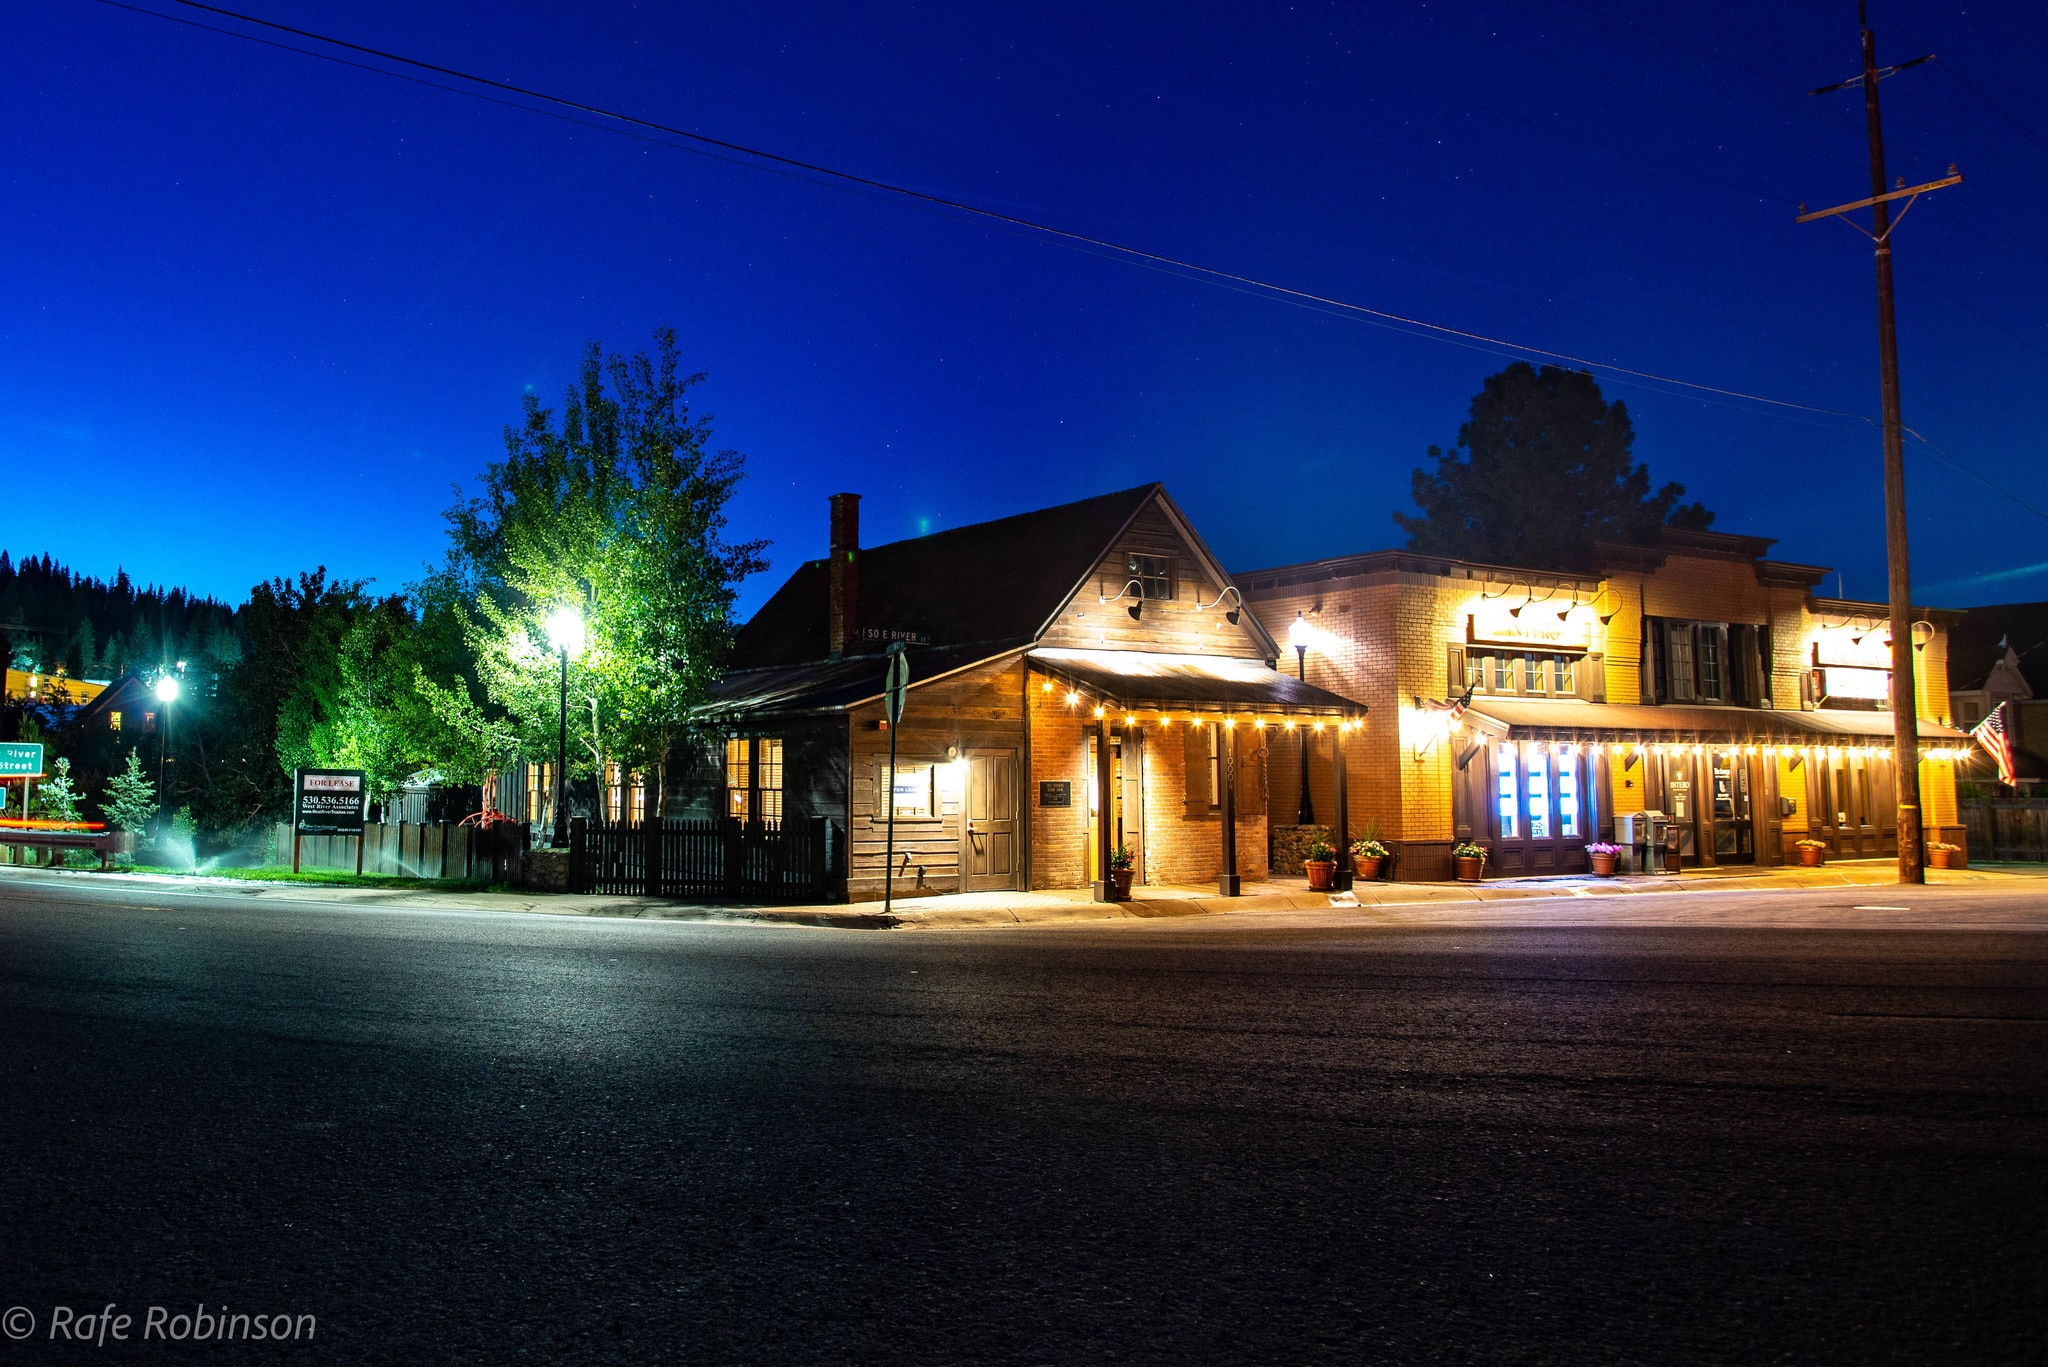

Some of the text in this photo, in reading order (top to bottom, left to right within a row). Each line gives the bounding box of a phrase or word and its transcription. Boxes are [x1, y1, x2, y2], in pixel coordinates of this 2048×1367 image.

[868, 629, 879, 638] SO
[882, 629, 888, 639] E
[891, 631, 917, 641] RIVER
[1670, 781, 1690, 789] INTERO
[303, 796, 360, 805] 530.536.5166
